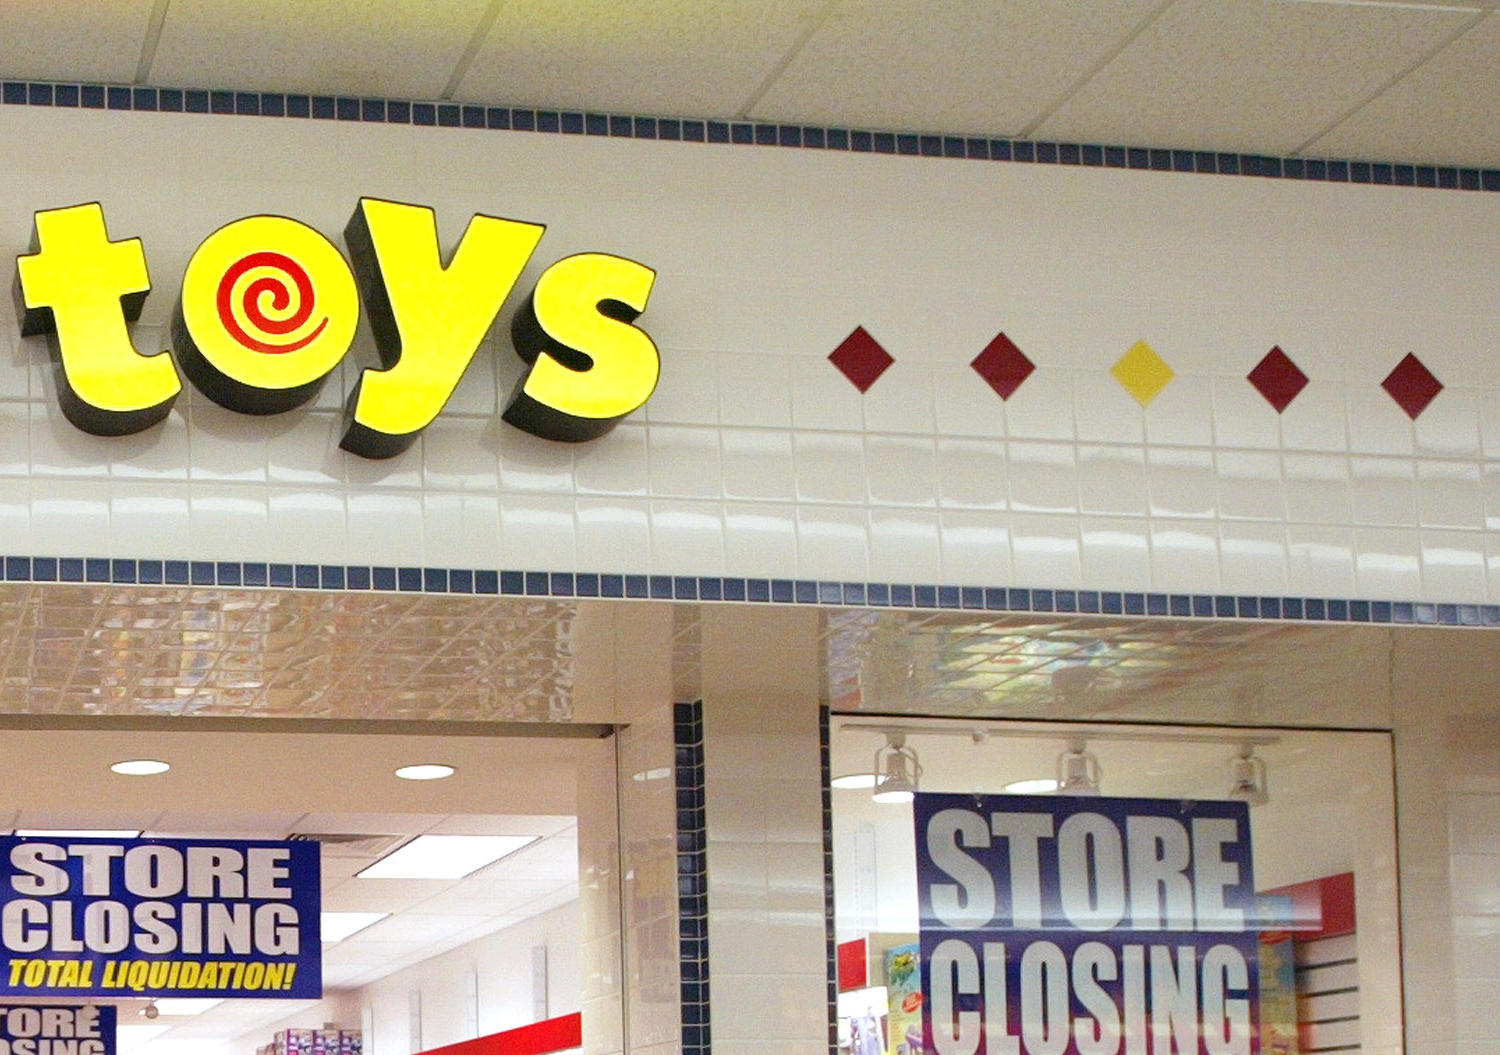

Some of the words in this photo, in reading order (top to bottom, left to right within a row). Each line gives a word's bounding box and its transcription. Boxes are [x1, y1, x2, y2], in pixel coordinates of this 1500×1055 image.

[18, 196, 662, 440] toys
[10, 842, 292, 899] STORE
[926, 809, 1245, 932] STORE
[1, 900, 299, 955] CLOSING
[9, 959, 93, 988] TOTAL
[101, 960, 295, 991] LIQUIDATION!
